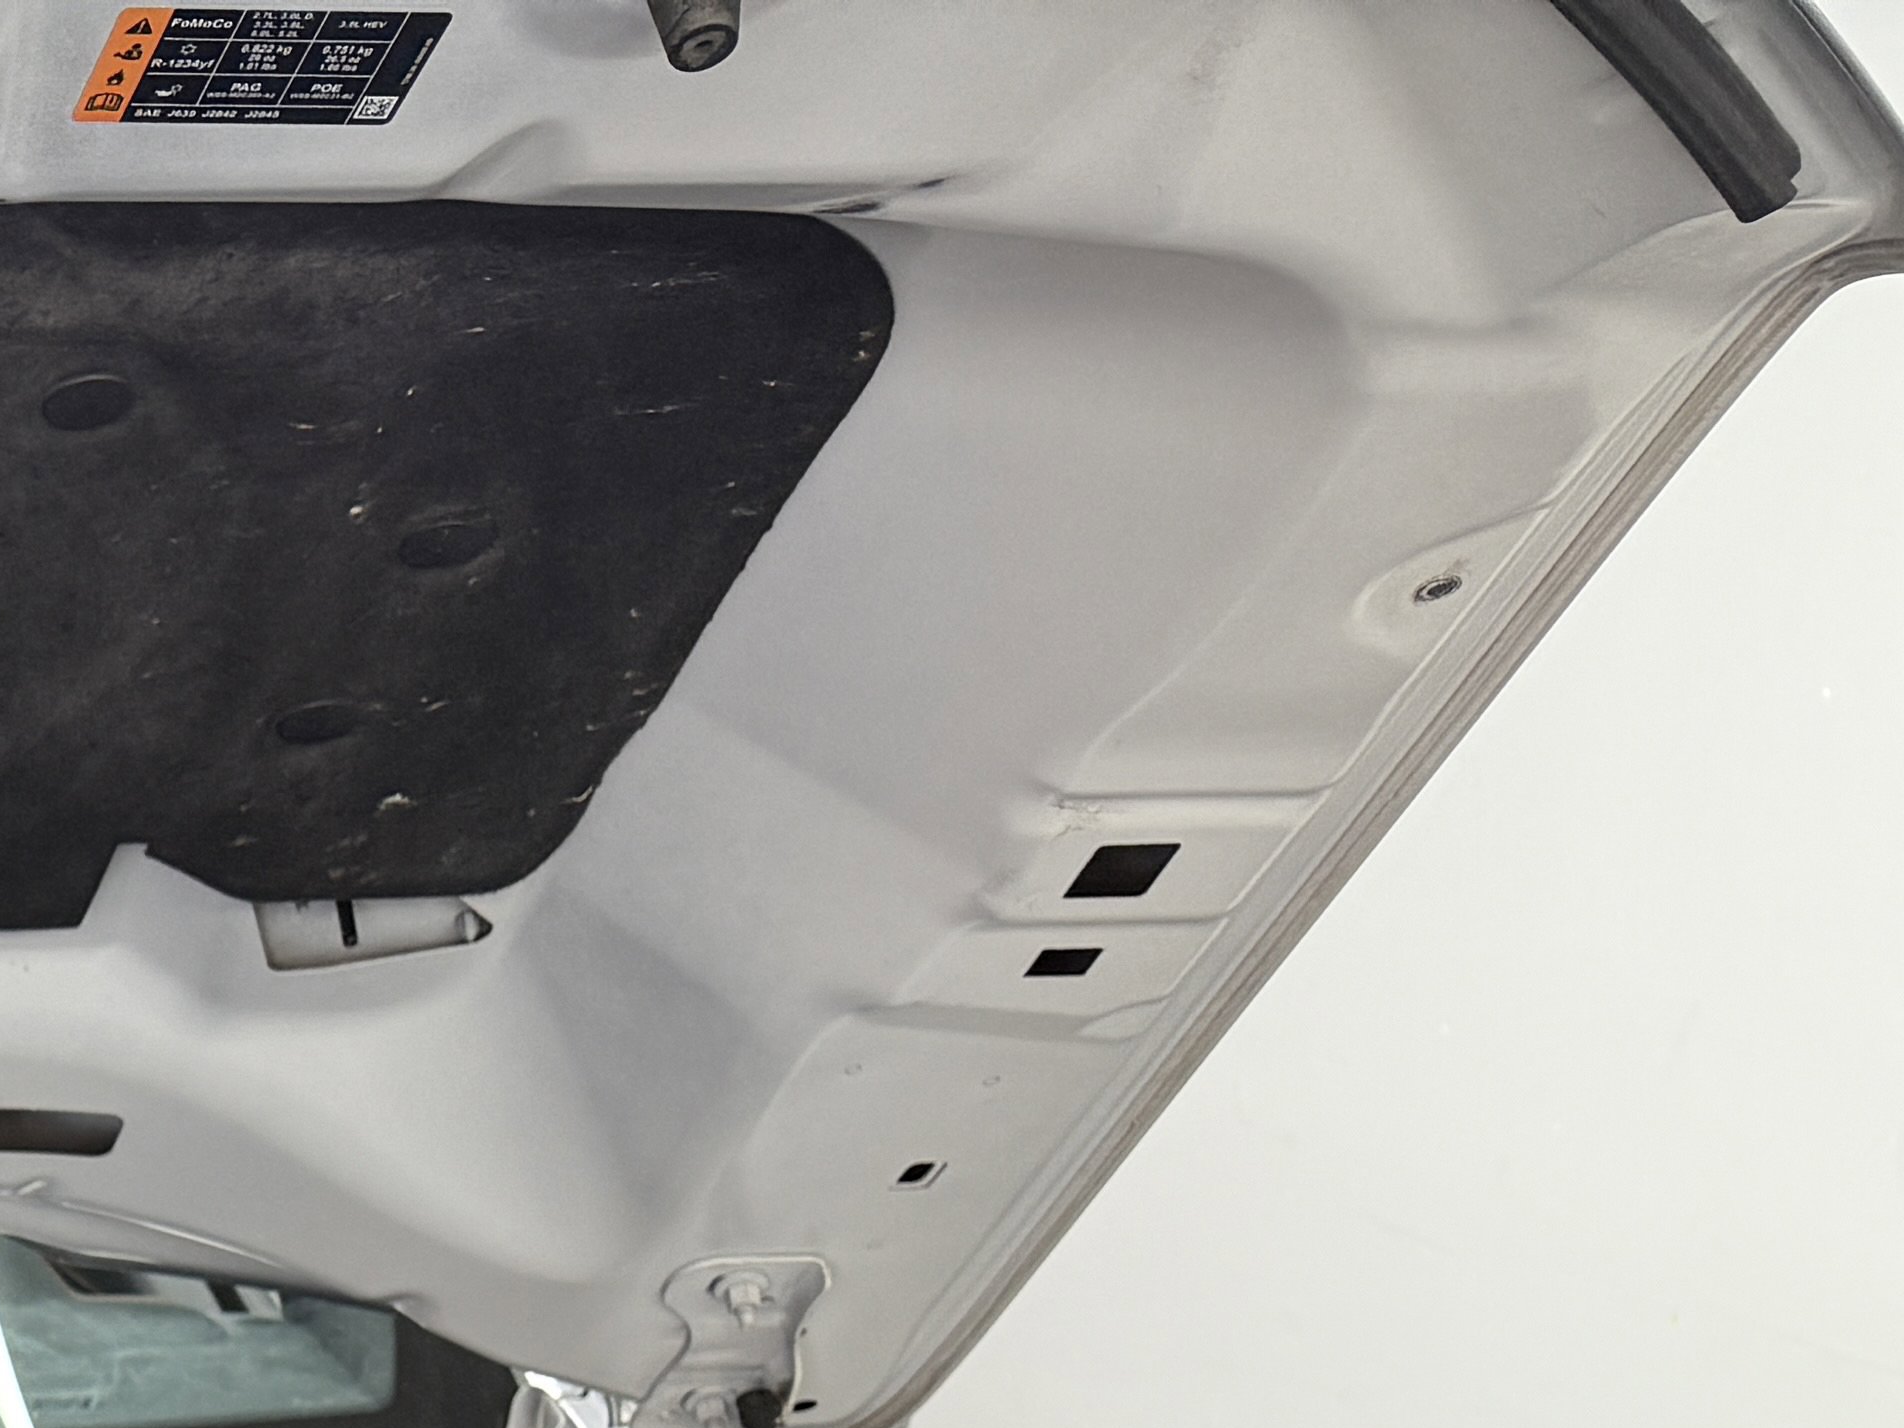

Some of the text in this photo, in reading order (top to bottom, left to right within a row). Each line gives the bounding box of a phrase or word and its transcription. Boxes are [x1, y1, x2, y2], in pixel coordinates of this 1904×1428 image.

[170, 17, 233, 29] FoMoCo
[151, 58, 215, 71] R-1234yf
[230, 82, 262, 92] PAG
[310, 83, 344, 93] POE
[133, 108, 162, 118] SAE
